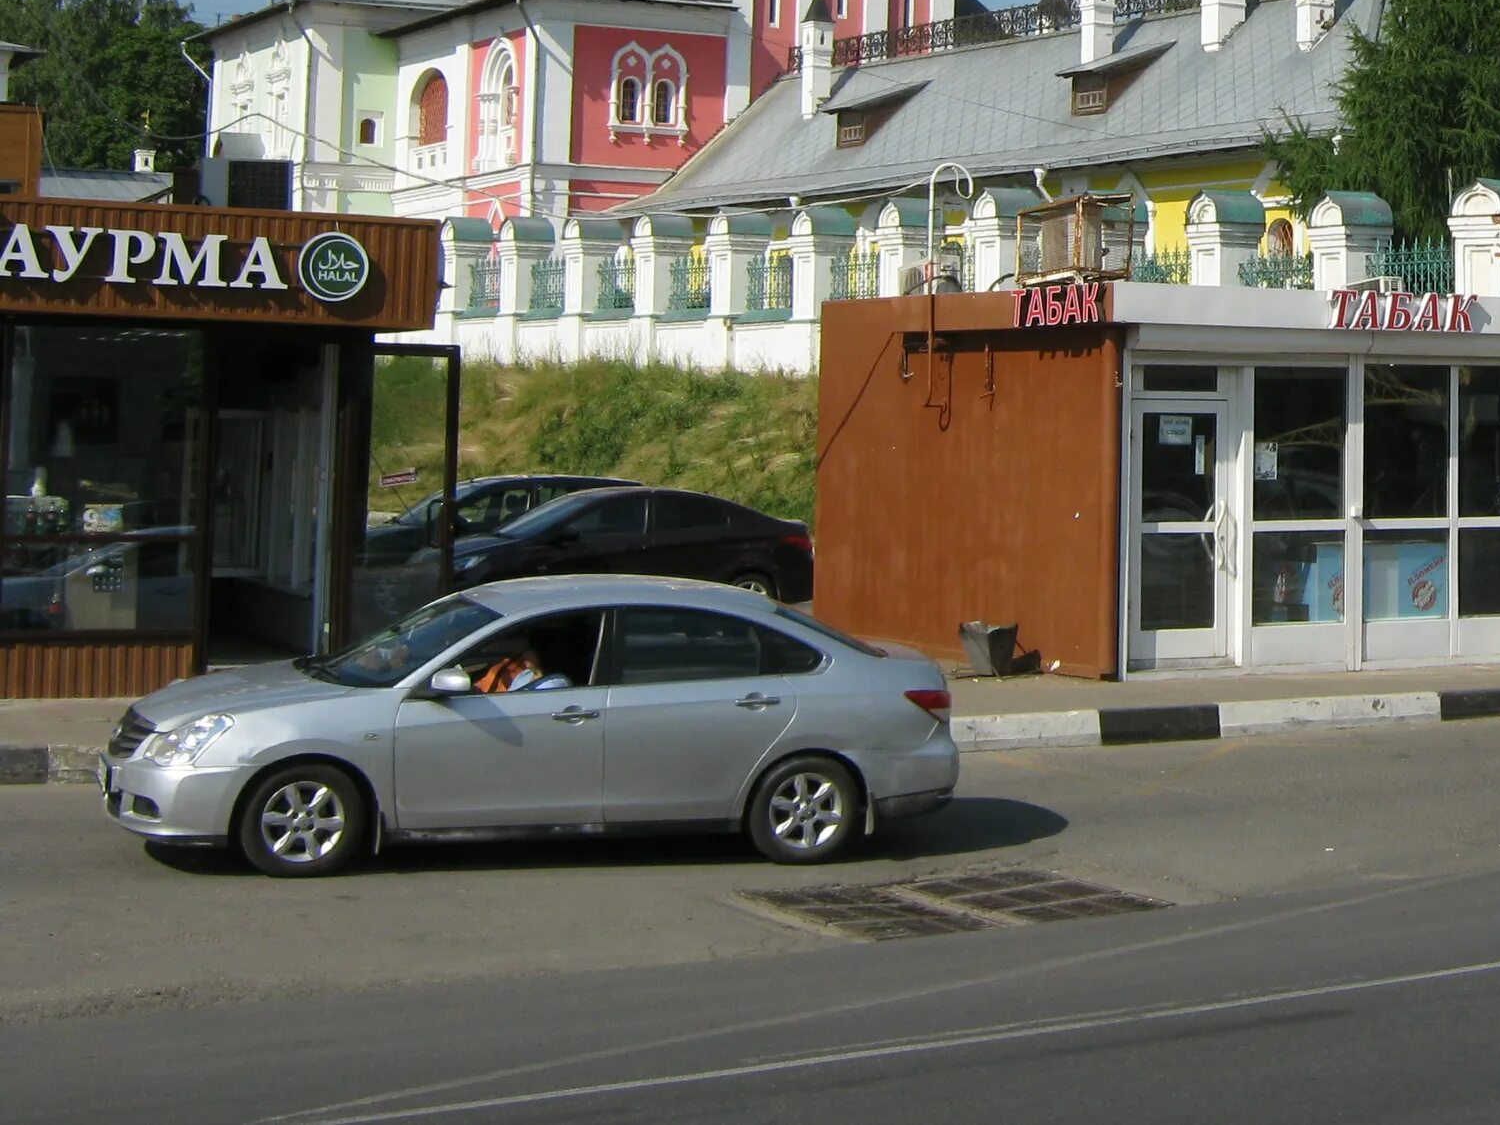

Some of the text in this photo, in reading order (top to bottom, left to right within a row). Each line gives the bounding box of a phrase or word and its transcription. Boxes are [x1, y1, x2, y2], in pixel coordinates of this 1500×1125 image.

[0, 223, 288, 290] АУРМА
[318, 249, 360, 270] حلال
[318, 270, 359, 283] HALAL
[1010, 281, 1099, 327] ТАБАК
[1327, 288, 1478, 333] ТАБАК
